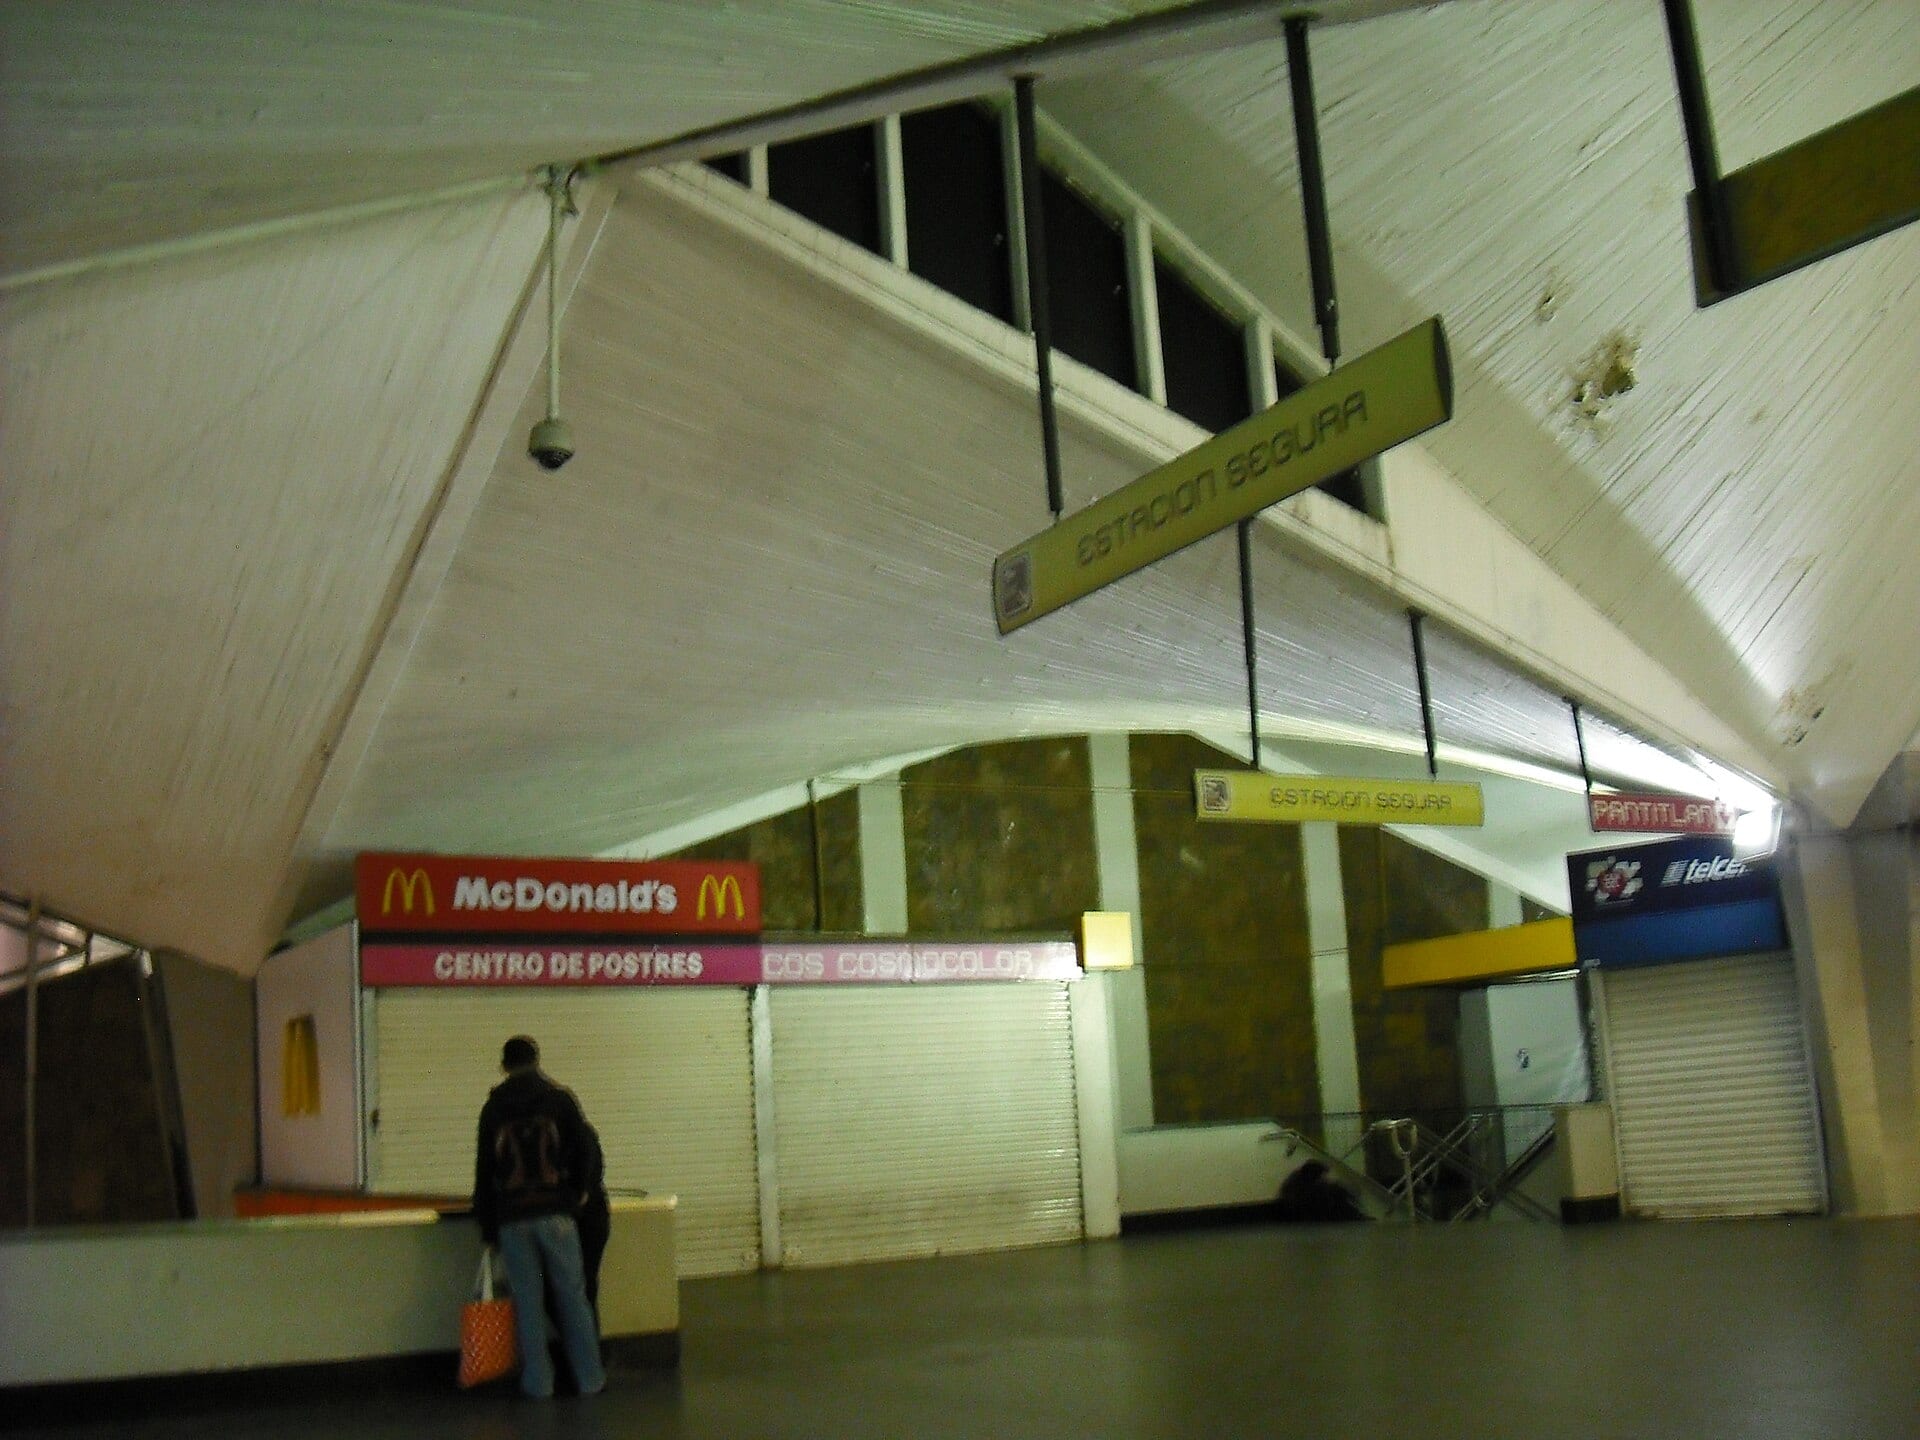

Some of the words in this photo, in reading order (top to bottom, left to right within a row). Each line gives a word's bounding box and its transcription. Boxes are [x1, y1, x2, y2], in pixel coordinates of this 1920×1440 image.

[1076, 470, 1218, 567] ESTACION
[1225, 390, 1369, 488] SEGURA
[1270, 787, 1371, 810] ESTACION
[1376, 791, 1451, 810] SEGURA
[453, 876, 678, 914] McDonald's
[434, 952, 544, 979] CENTRO
[550, 953, 584, 979] DE
[588, 952, 703, 980] POSTRES
